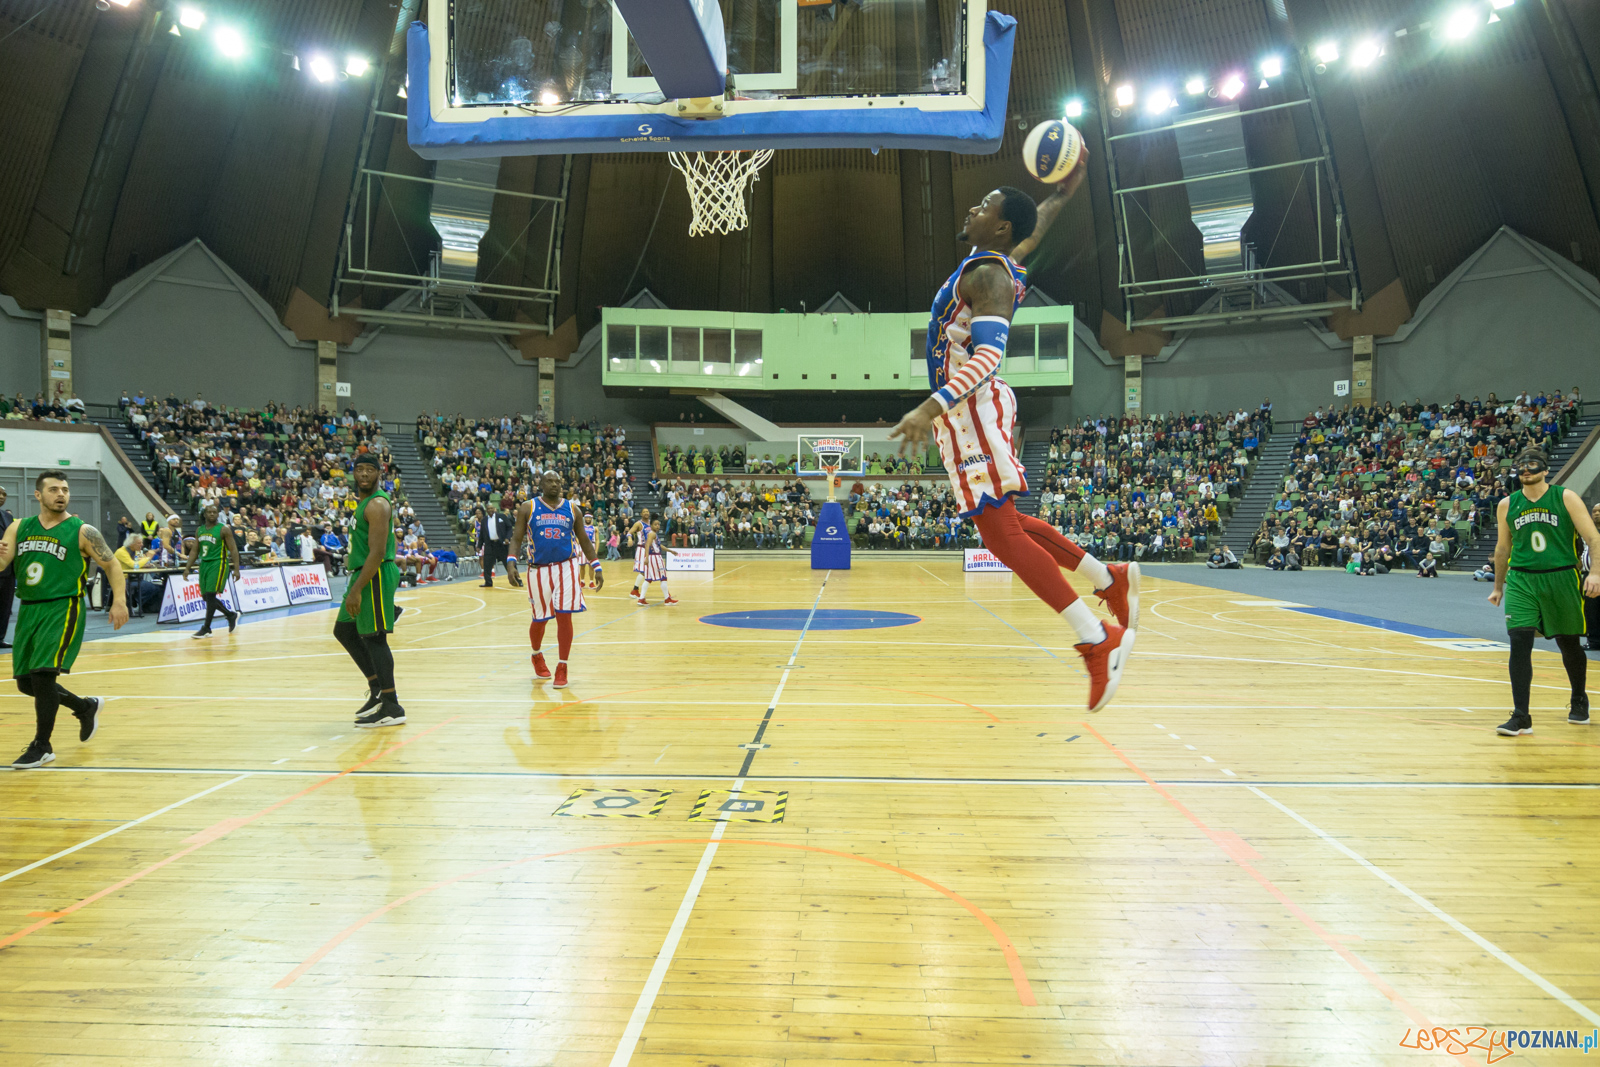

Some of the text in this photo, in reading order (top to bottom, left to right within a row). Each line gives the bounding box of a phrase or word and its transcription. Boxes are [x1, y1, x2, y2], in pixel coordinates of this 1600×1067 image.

[338, 385, 348, 393] A1
[817, 438, 845, 447] HARLEM
[812, 445, 850, 453] GLOBETROTTERS
[958, 454, 993, 474] HARLEM
[540, 513, 567, 521] HARLEM
[1514, 512, 1558, 530] GENERALS
[26, 535, 60, 544] WASHINGTON
[545, 528, 561, 540] 52
[1531, 531, 1547, 552] 0
[17, 540, 67, 561] GENERALS
[202, 545, 209, 557] 5
[973, 554, 1000, 562] HARLE
[26, 561, 44, 586] 9
[291, 573, 321, 588] HARLEM
[290, 586, 329, 600] GLOBETROTTERS
